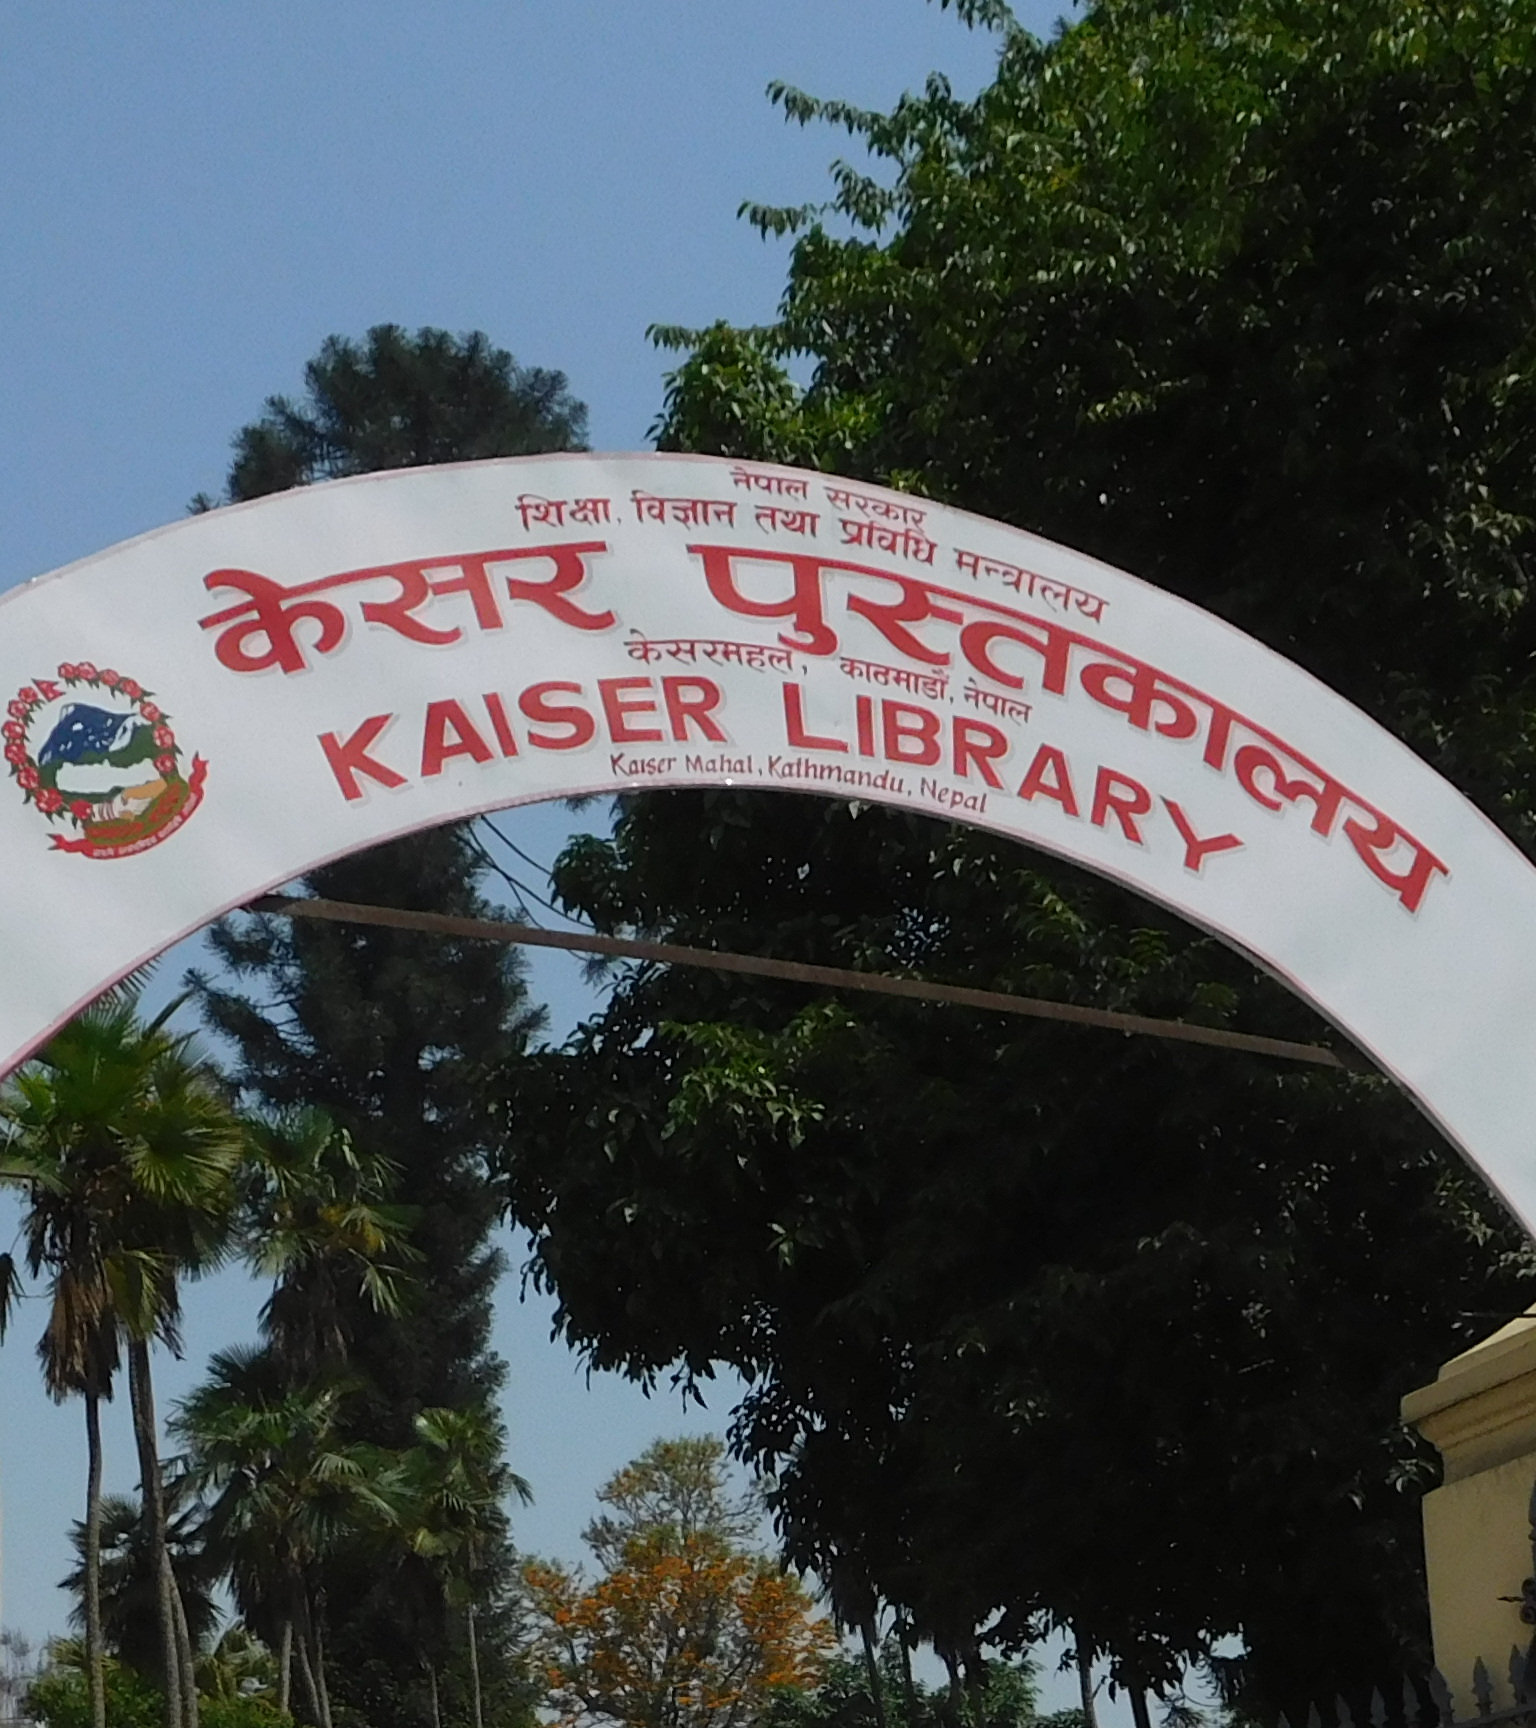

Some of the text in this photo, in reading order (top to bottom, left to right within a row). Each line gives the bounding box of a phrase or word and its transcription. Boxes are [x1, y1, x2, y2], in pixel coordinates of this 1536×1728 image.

[629, 489, 738, 530] विज्ञान
[754, 503, 821, 538] तथा
[839, 516, 939, 566] प्रविधि
[730, 467, 928, 533] नेपाल सरकार
[197, 540, 1450, 913] केसर पुस्तकालय
[963, 676, 1033, 726] नेपाल
[316, 676, 1246, 872] KAISER LIBRARY
[610, 752, 678, 778] Kaiser
[920, 777, 988, 815] Nepal
